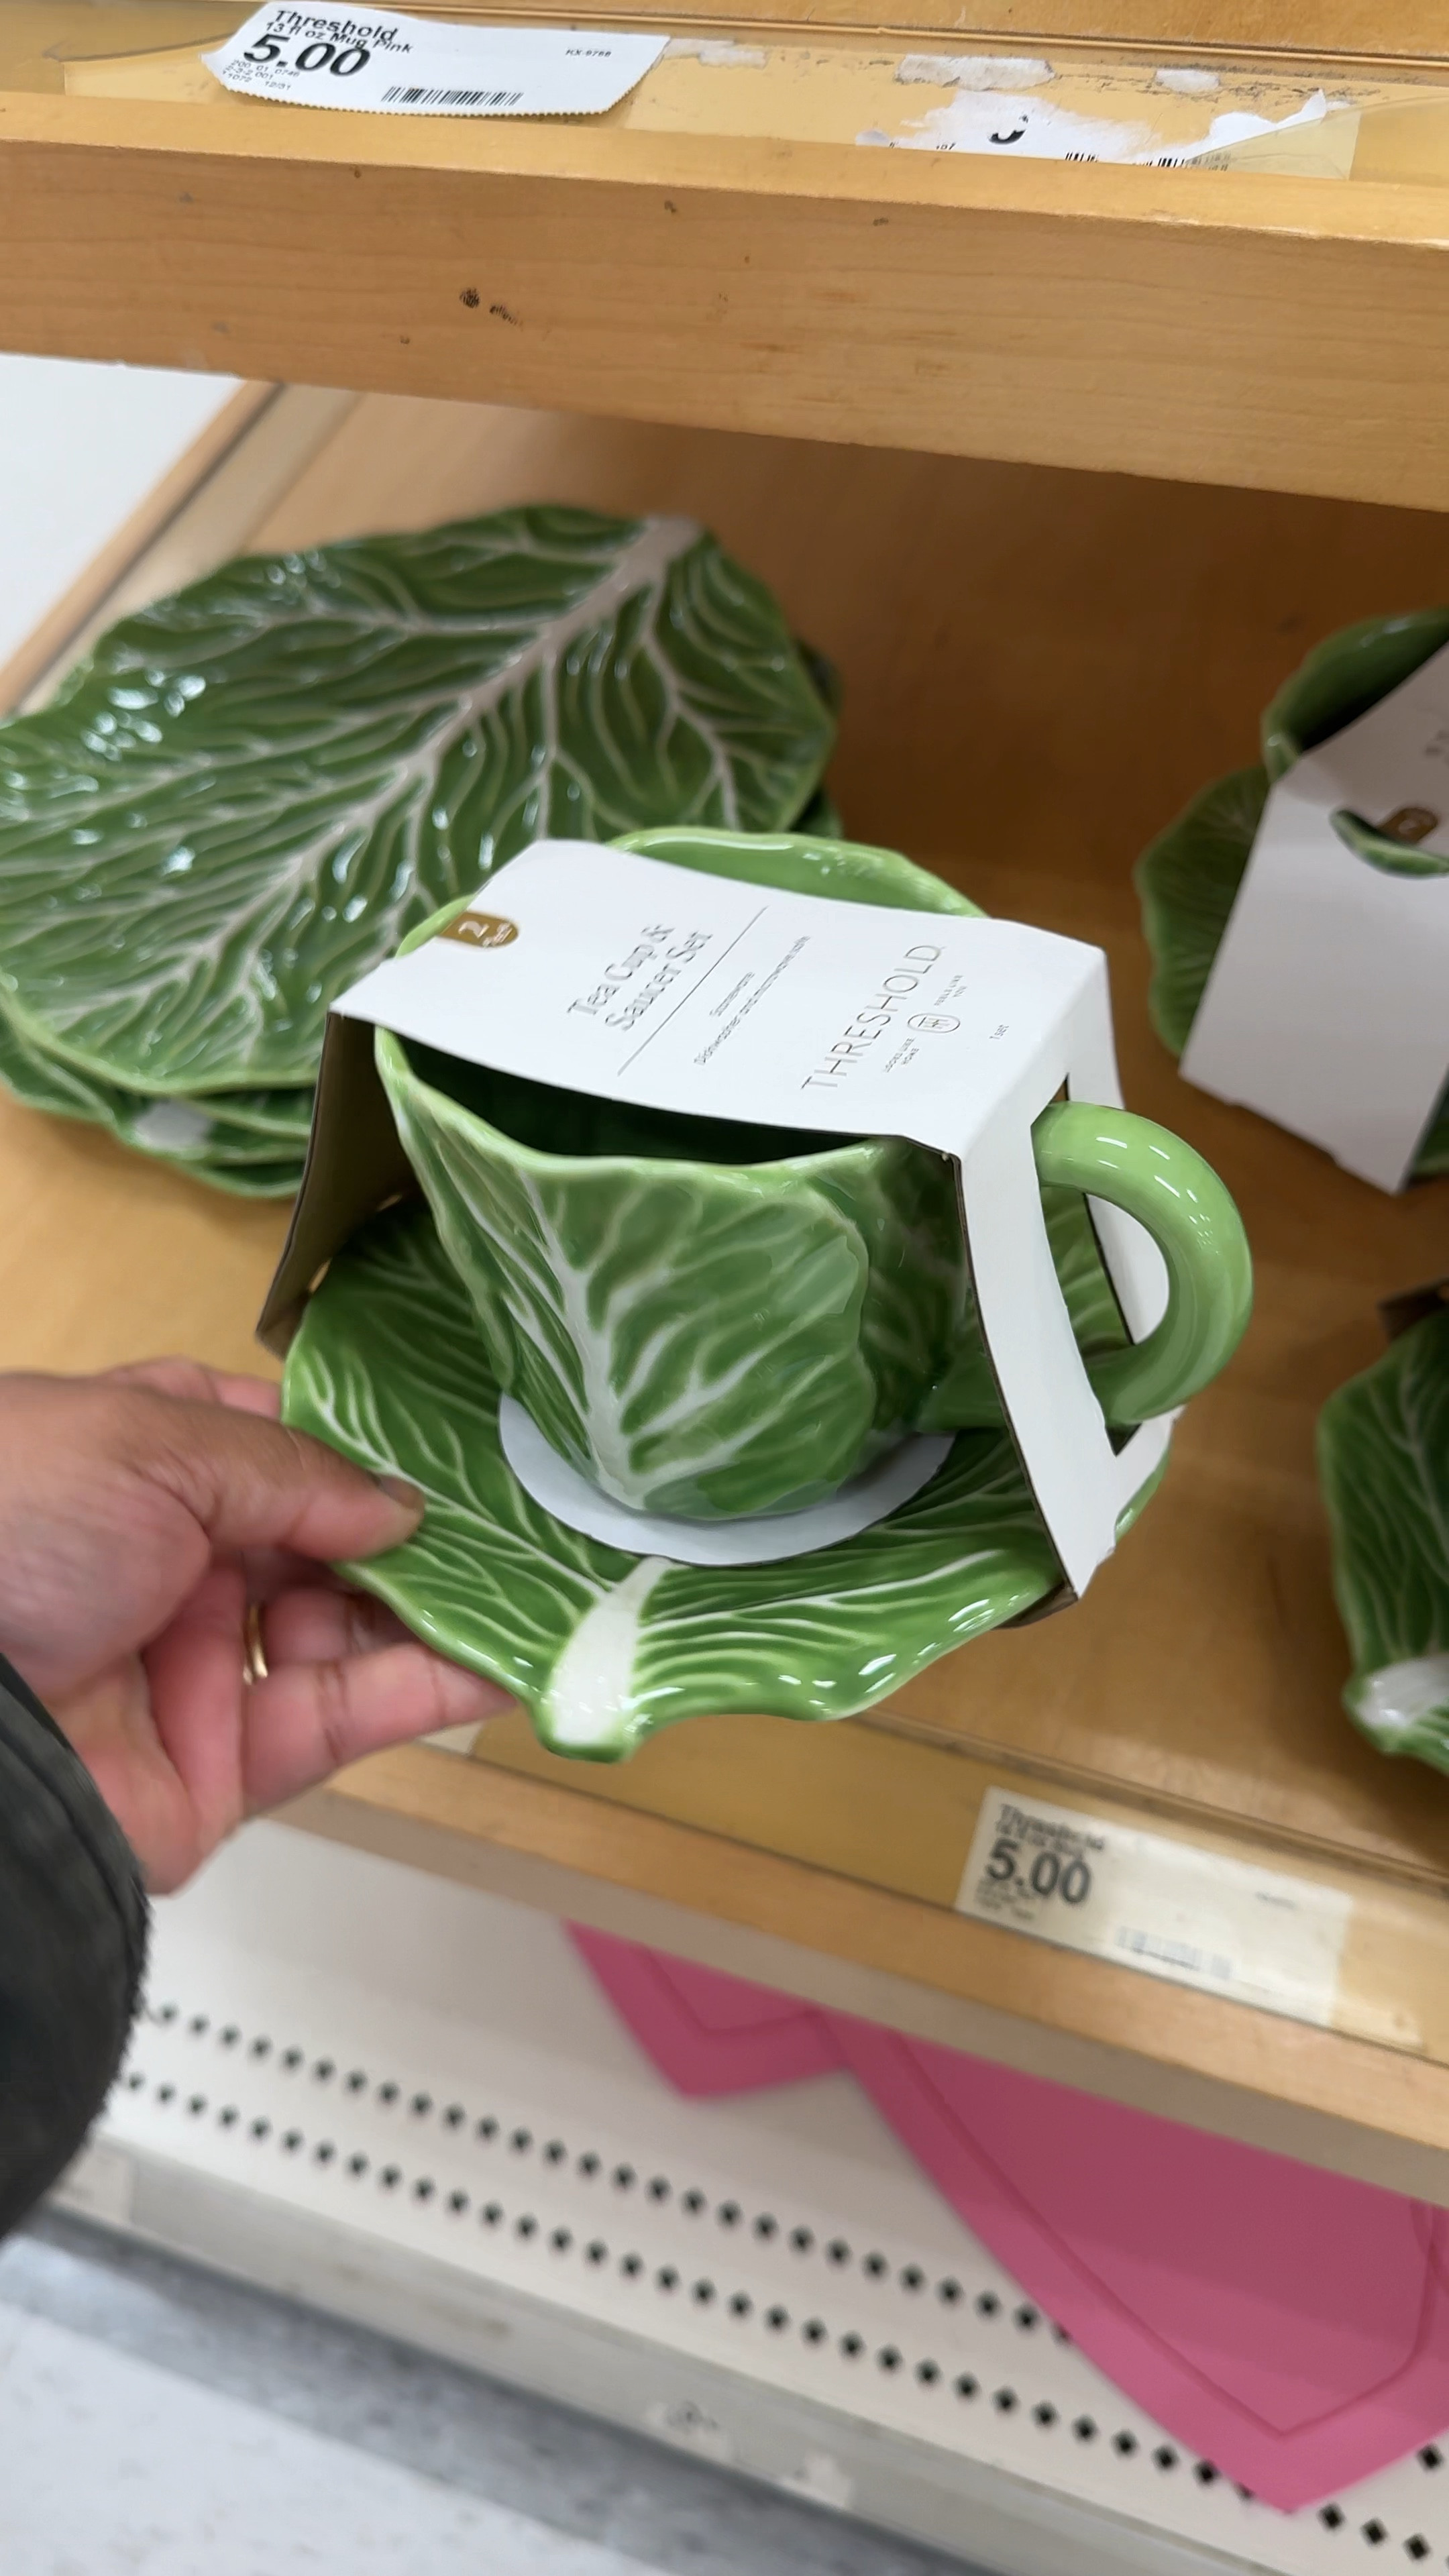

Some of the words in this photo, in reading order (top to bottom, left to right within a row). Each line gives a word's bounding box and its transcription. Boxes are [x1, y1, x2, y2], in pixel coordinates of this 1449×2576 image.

[266, 22, 282, 32] 13
[289, 25, 301, 35] fl
[305, 31, 323, 40] oz
[329, 33, 368, 49] Mug
[374, 38, 414, 54] Pink
[274, 10, 398, 40] Threshold
[243, 34, 371, 76] 5.00
[458, 920, 490, 938] 2
[566, 984, 621, 1016] Tea
[604, 944, 658, 981] Cup
[604, 963, 682, 1032] Saucer
[665, 930, 714, 964] Set
[802, 944, 942, 1088] THRESHOLD
[985, 1837, 1089, 1907] 5.00
